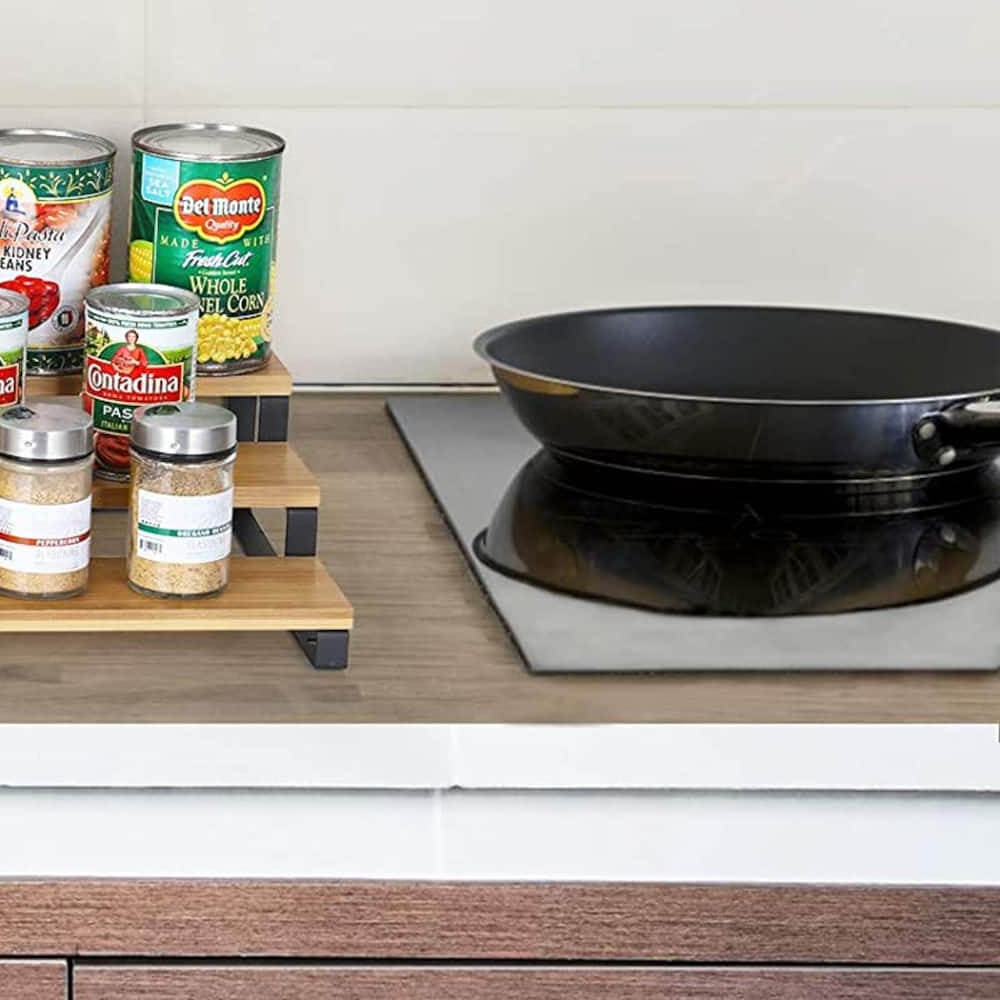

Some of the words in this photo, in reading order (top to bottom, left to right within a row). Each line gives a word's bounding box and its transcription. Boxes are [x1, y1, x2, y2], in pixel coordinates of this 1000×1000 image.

[179, 196, 209, 215] Del
[212, 197, 261, 215] Monte
[160, 234, 199, 249] MADE
[3, 245, 52, 261] KIDNEY
[182, 249, 222, 268] Fresh
[189, 275, 248, 296] WHOLE
[227, 291, 265, 313] CORN
[87, 363, 179, 395] Contadina
[103, 404, 133, 420] PAS
